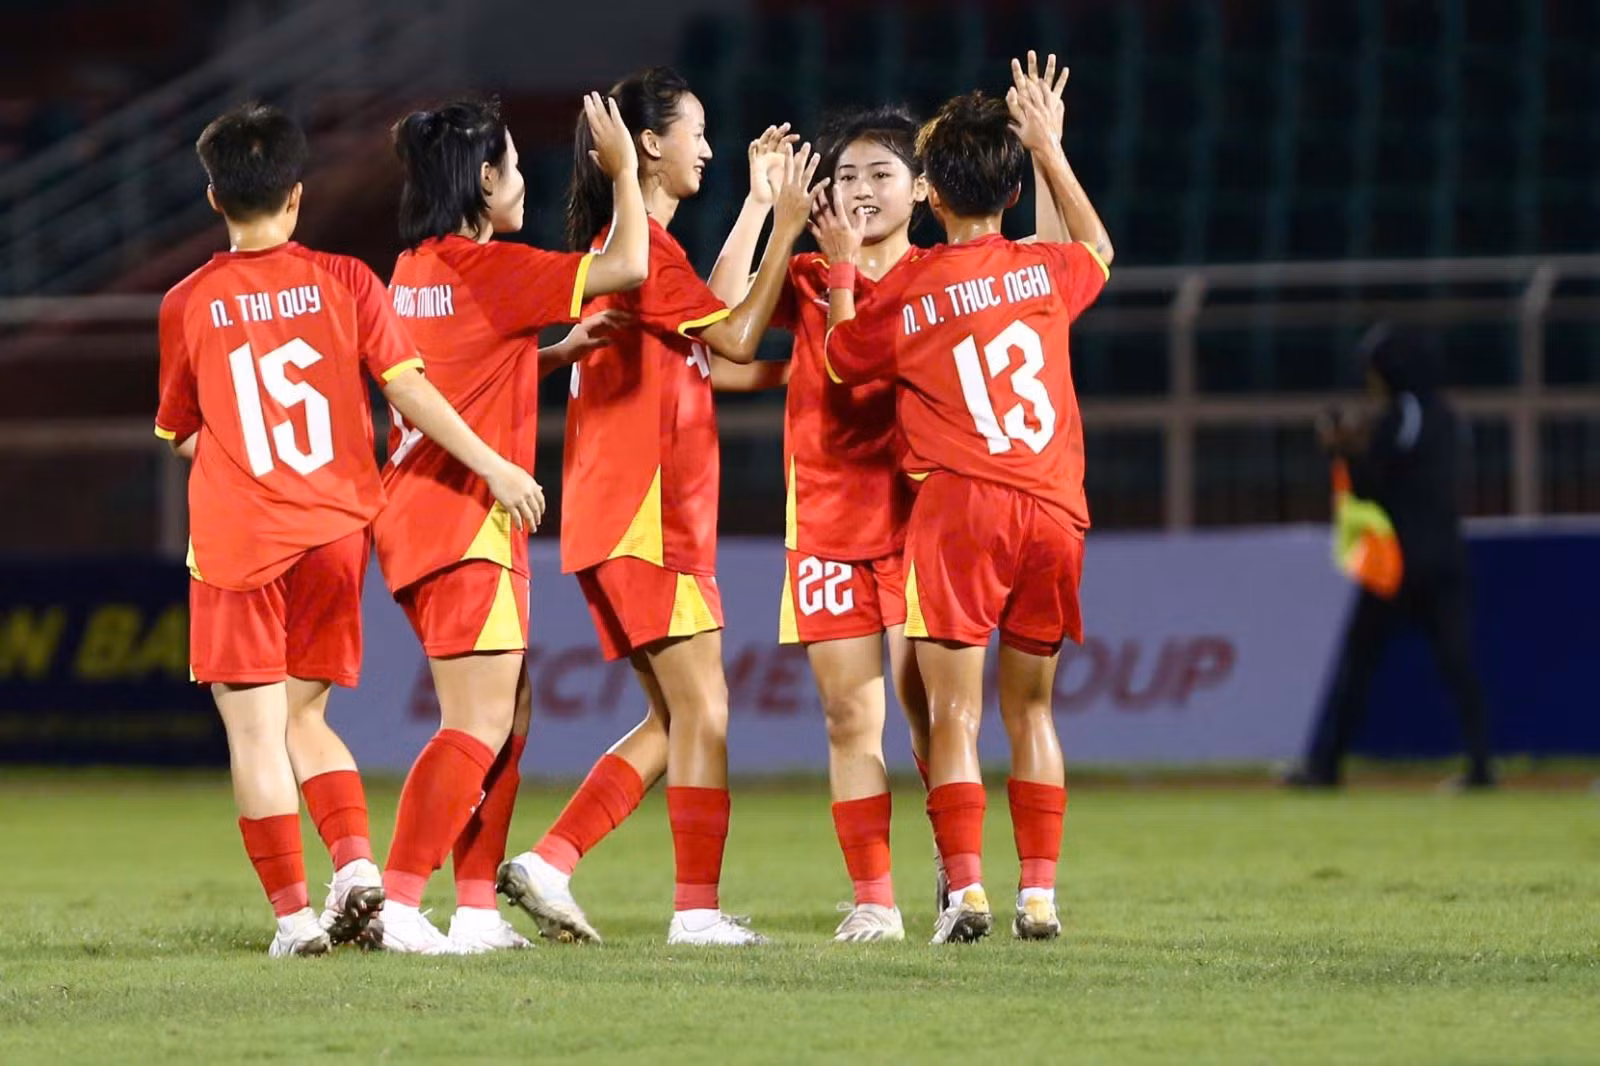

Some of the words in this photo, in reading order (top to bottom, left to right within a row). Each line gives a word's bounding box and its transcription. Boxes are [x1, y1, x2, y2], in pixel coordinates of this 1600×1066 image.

[234, 292, 273, 322] THI
[276, 285, 322, 320] QUY
[921, 294, 945, 325] V.
[944, 275, 1002, 317] THUC
[1002, 263, 1051, 304] NGHI
[228, 337, 334, 478] 15
[952, 319, 1056, 455] 13
[798, 555, 854, 617] 22
[983, 634, 1237, 713] OUP
